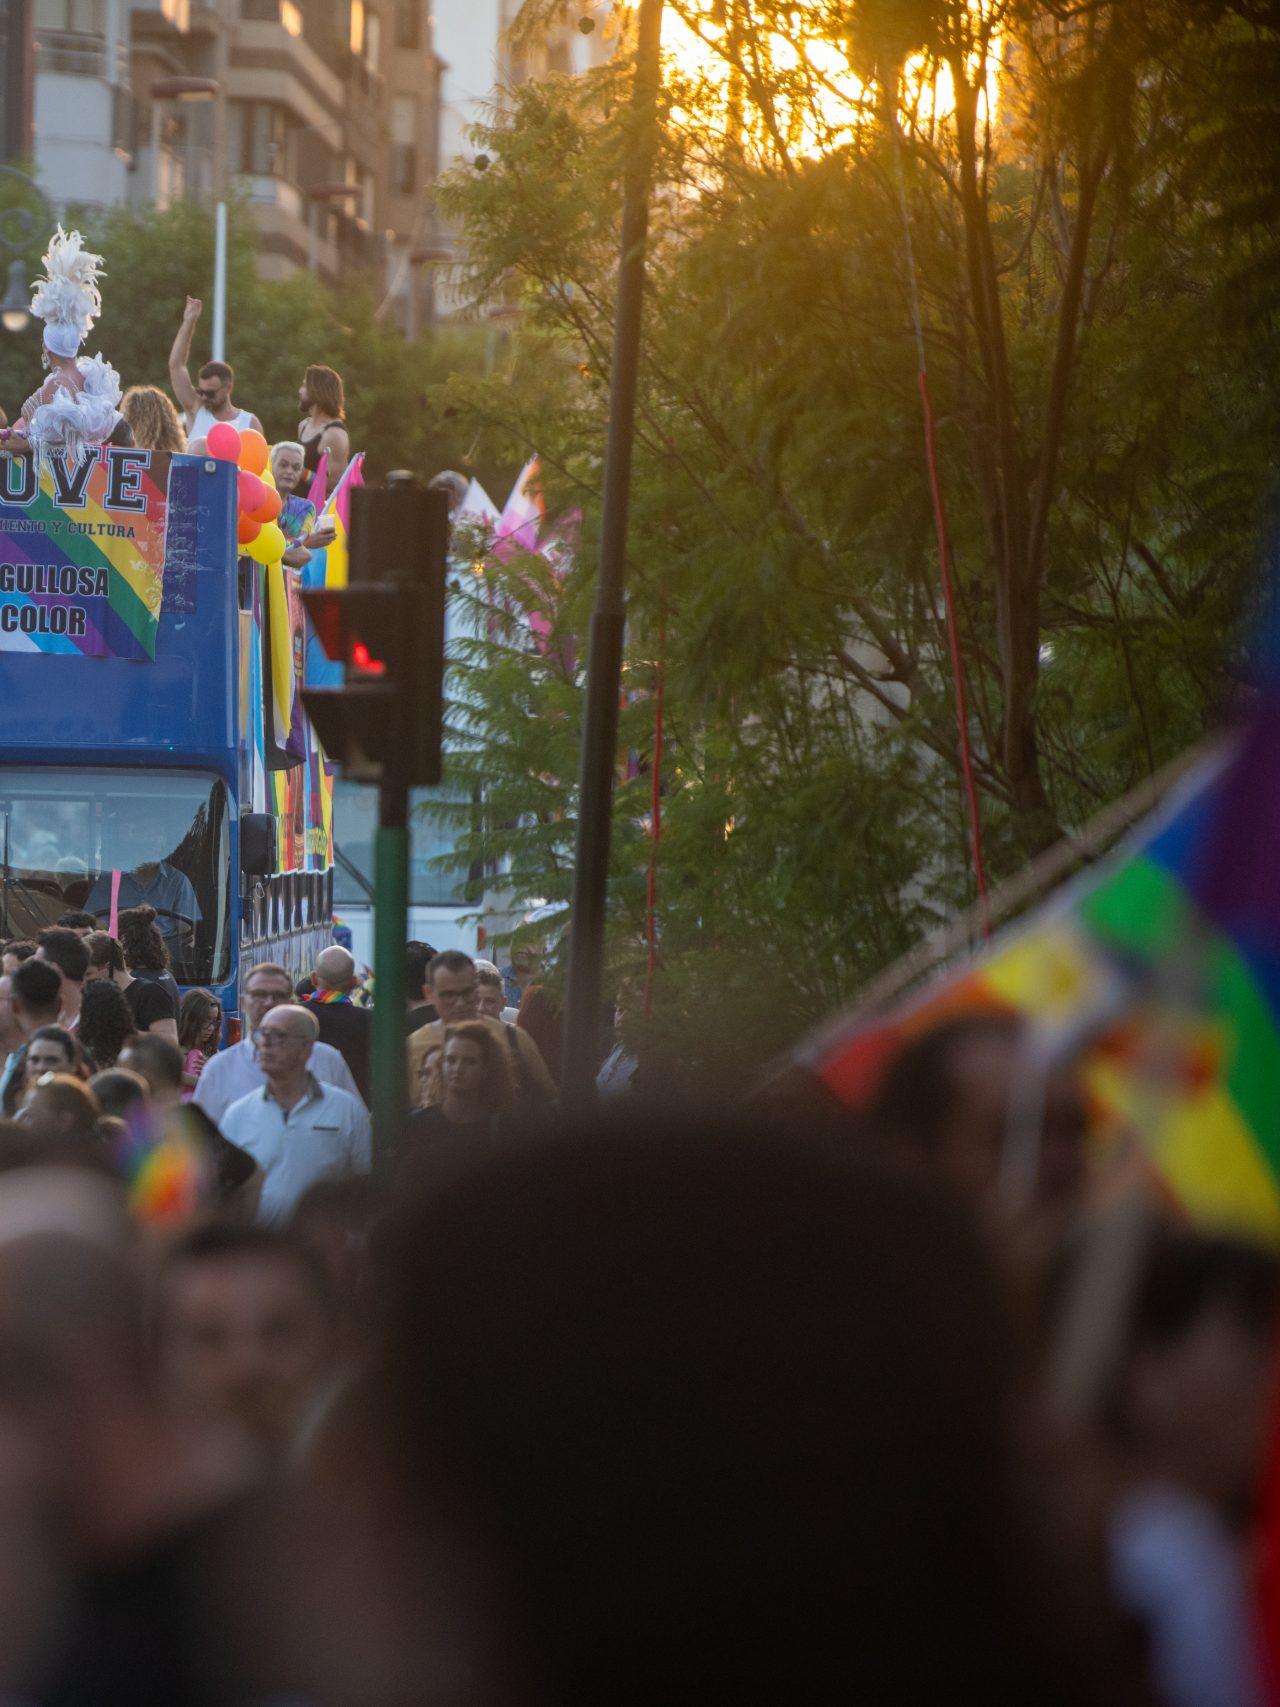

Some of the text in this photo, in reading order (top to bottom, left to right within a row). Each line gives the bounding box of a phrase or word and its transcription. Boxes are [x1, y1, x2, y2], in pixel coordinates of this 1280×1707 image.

[52, 521, 64, 533] Y
[67, 522, 136, 539] CULTURA
[1, 605, 86, 636] COLOR
